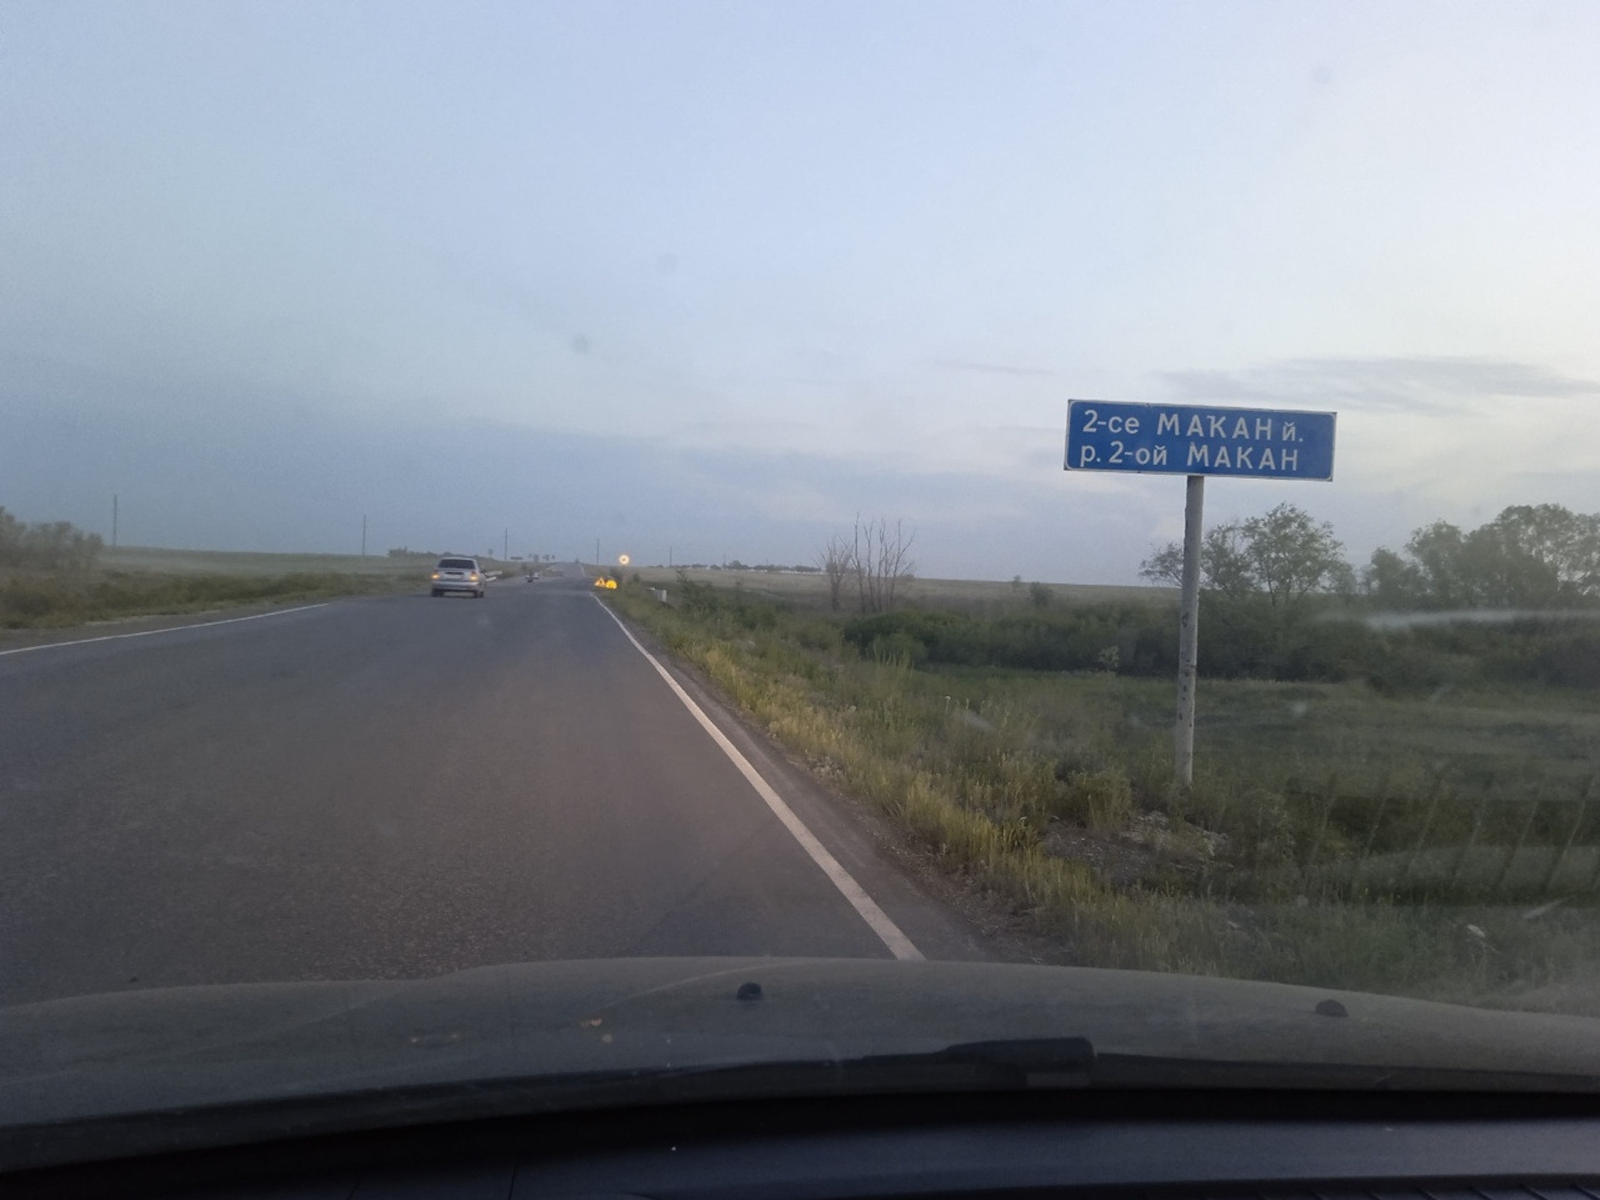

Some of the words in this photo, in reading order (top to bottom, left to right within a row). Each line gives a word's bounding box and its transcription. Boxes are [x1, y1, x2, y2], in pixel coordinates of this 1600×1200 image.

[1082, 409, 1140, 434] 2-се
[1282, 421, 1305, 442] й.
[1080, 445, 1101, 467] р.
[1108, 441, 1168, 466] 2-ой
[1187, 444, 1298, 471] МАКАН
